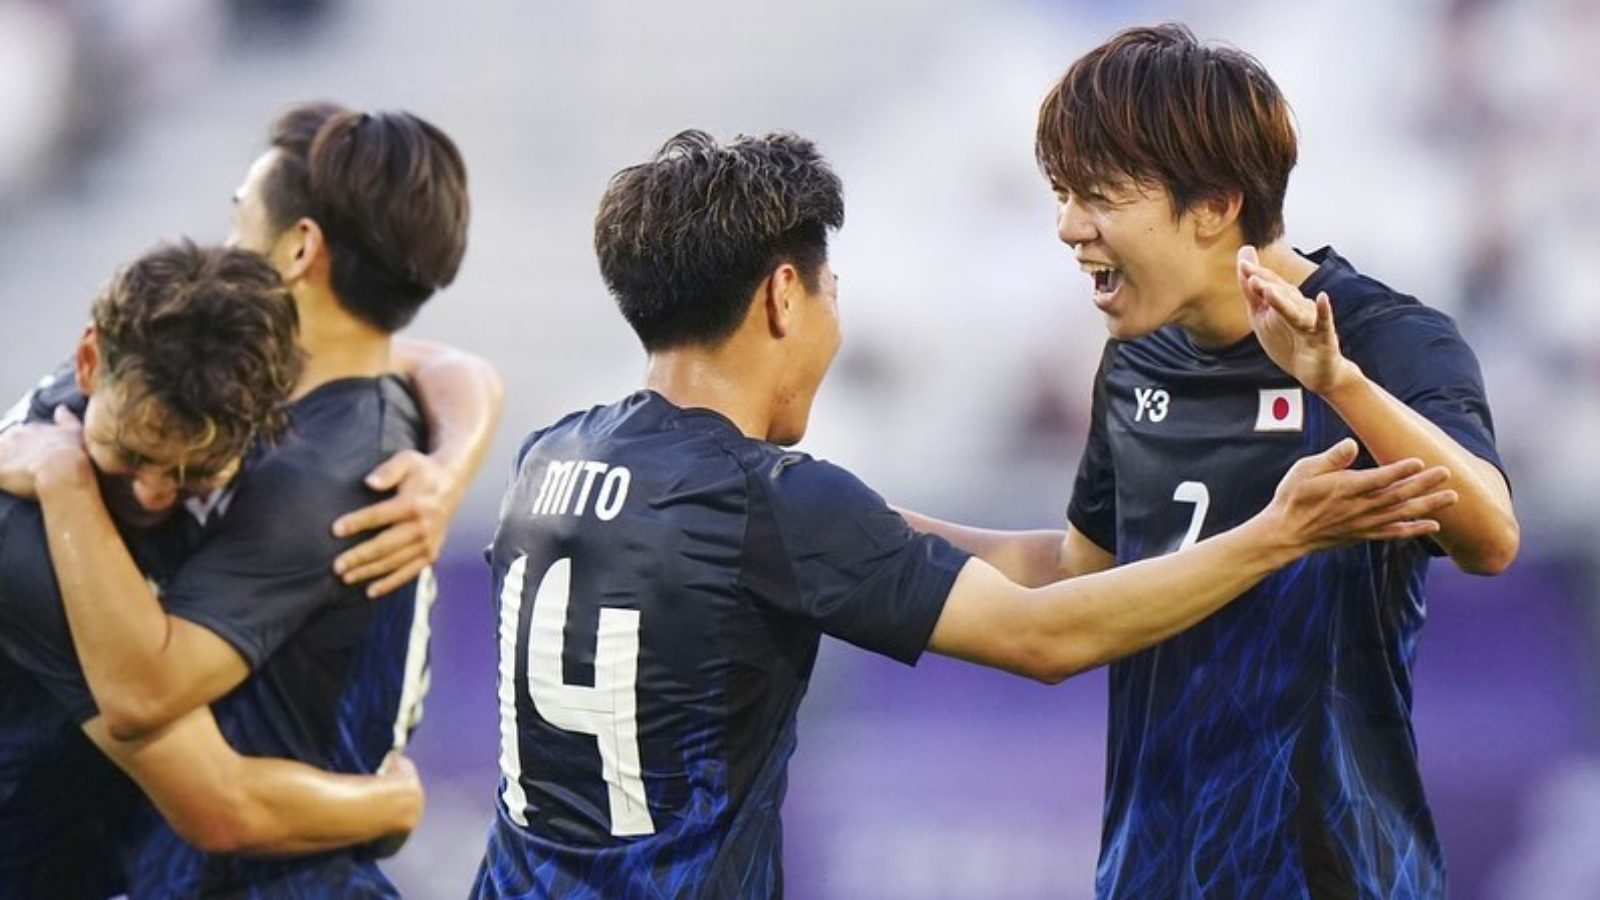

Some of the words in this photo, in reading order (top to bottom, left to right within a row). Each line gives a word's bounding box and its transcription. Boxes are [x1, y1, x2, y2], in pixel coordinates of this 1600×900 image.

[1134, 387, 1170, 422] Y-3
[532, 460, 631, 521] MITO
[499, 554, 655, 836] 14
